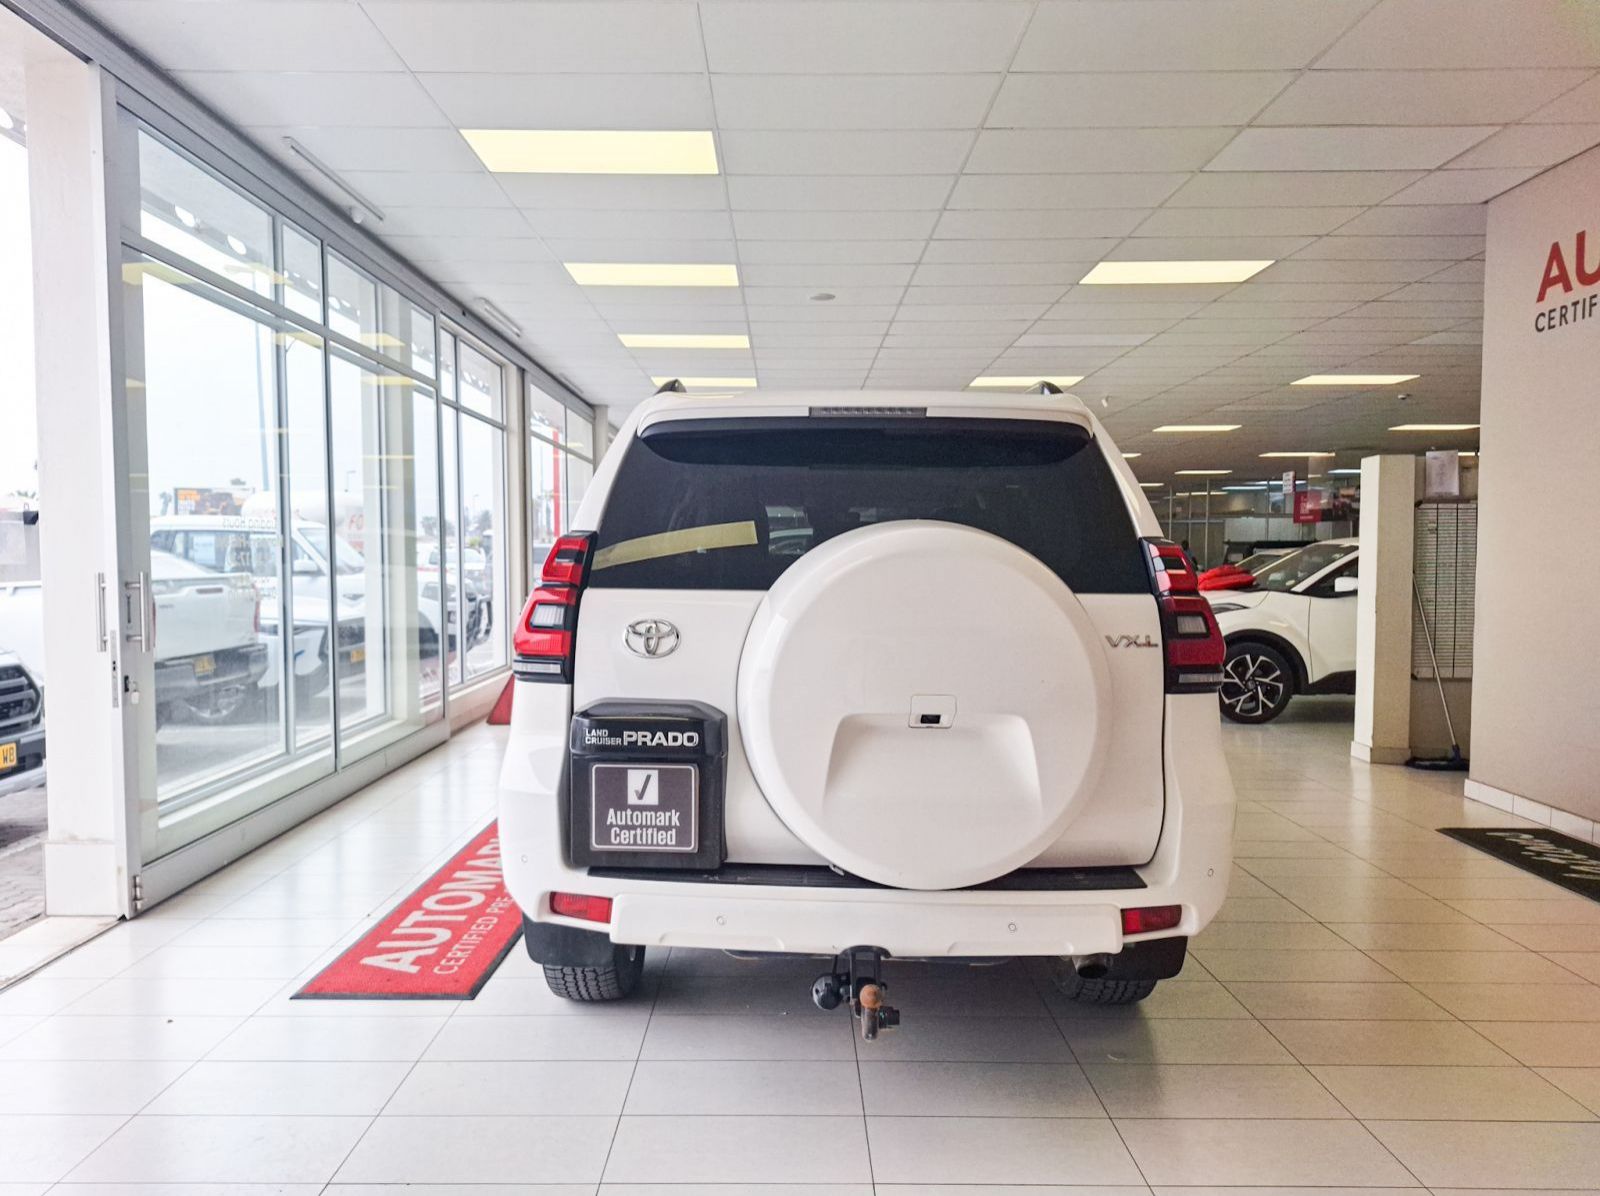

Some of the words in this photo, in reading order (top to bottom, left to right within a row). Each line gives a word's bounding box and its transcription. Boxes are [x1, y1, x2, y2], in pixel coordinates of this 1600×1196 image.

[1535, 294, 1598, 332] CERTIF
[585, 729, 609, 737] LAND
[585, 737, 622, 746] CRUISER
[623, 731, 699, 747] PRADO
[606, 808, 680, 826] Automark
[610, 827, 676, 846] Certified
[432, 916, 498, 975] CERTIFIED
